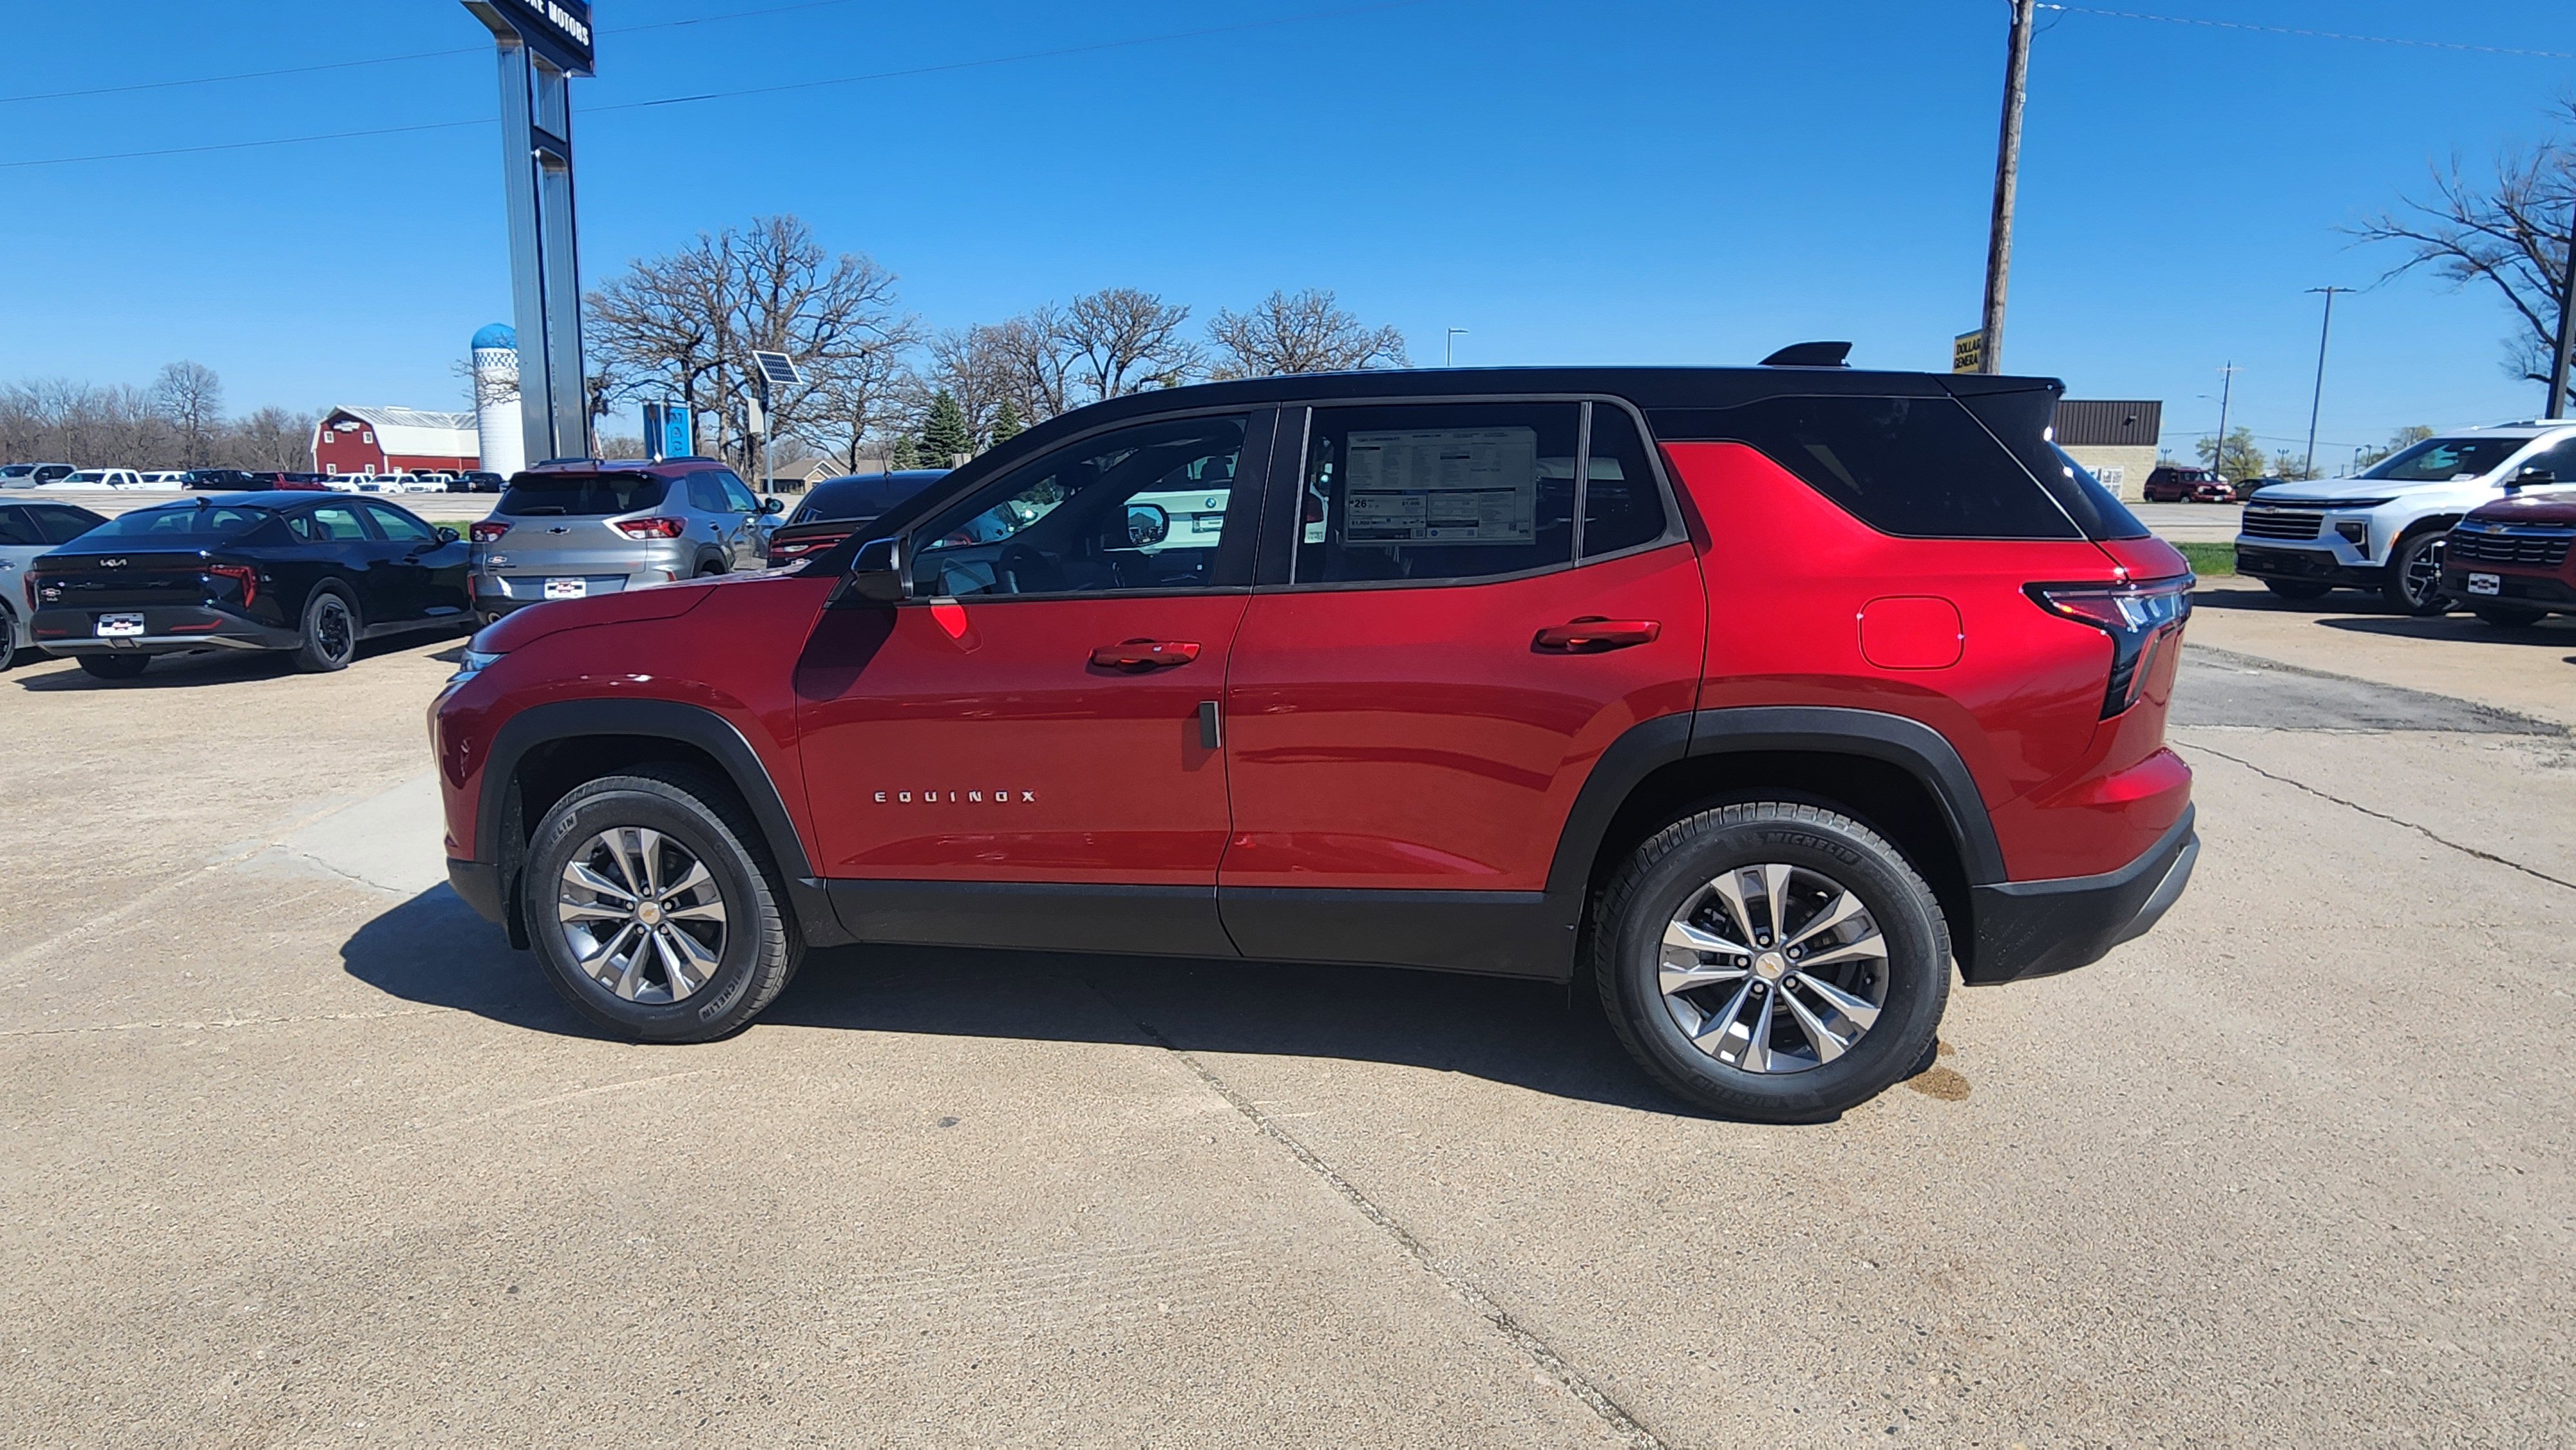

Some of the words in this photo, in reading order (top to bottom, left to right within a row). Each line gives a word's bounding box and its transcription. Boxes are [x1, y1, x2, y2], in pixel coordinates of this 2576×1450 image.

[548, 1, 589, 46] MOTORS
[1955, 352, 1979, 369] GENERA
[874, 790, 1036, 803] EQUINOX
[1765, 832, 1859, 864] MICHELIN
